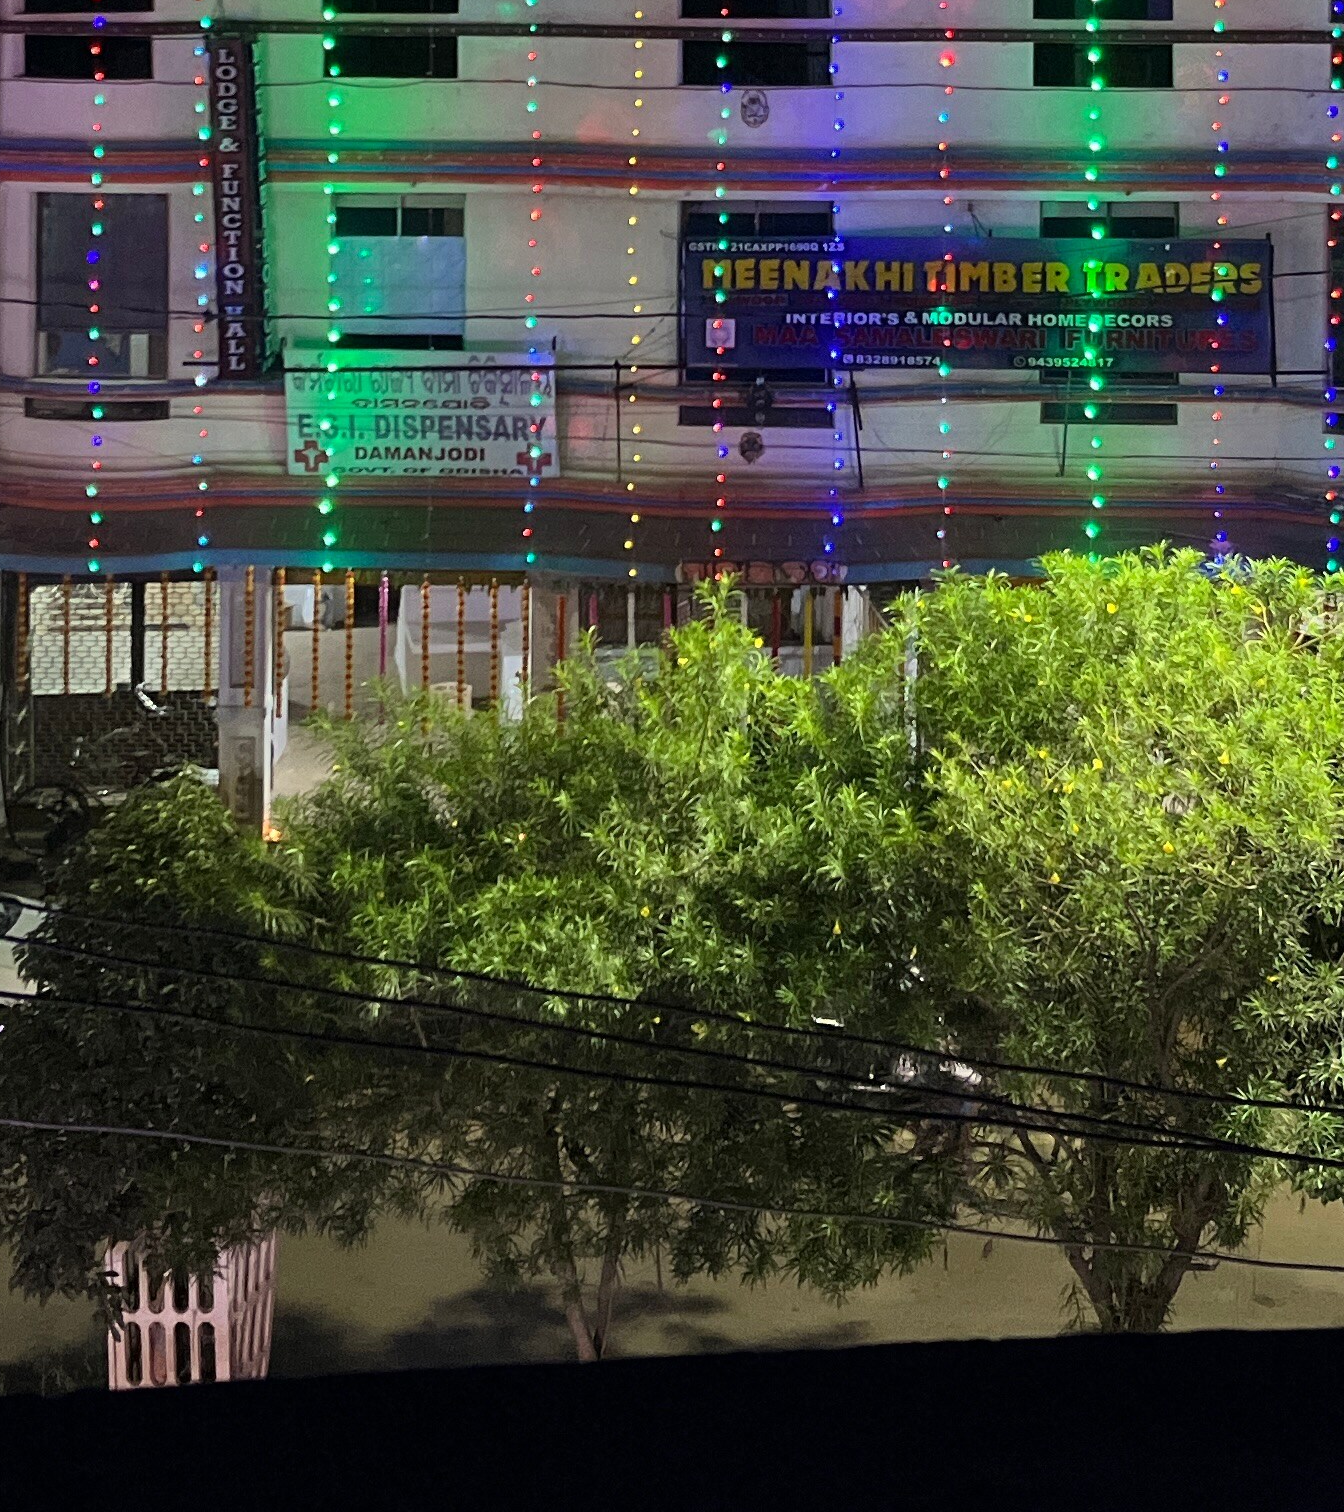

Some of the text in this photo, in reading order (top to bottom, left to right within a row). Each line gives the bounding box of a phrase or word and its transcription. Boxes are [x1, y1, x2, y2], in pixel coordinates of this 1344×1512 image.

[215, 48, 247, 371] LODGE & FUNCTION HALL
[702, 258, 1263, 294] MEENAKHI TIMBER TRADERS
[785, 312, 900, 325] INTERIOR'S
[904, 311, 918, 325] &
[922, 313, 1022, 326] MODULAR
[1027, 313, 1087, 327] HOME
[752, 325, 819, 346] MAA
[373, 414, 547, 441] DISPENSARY
[354, 446, 486, 462] DAMANJODI
